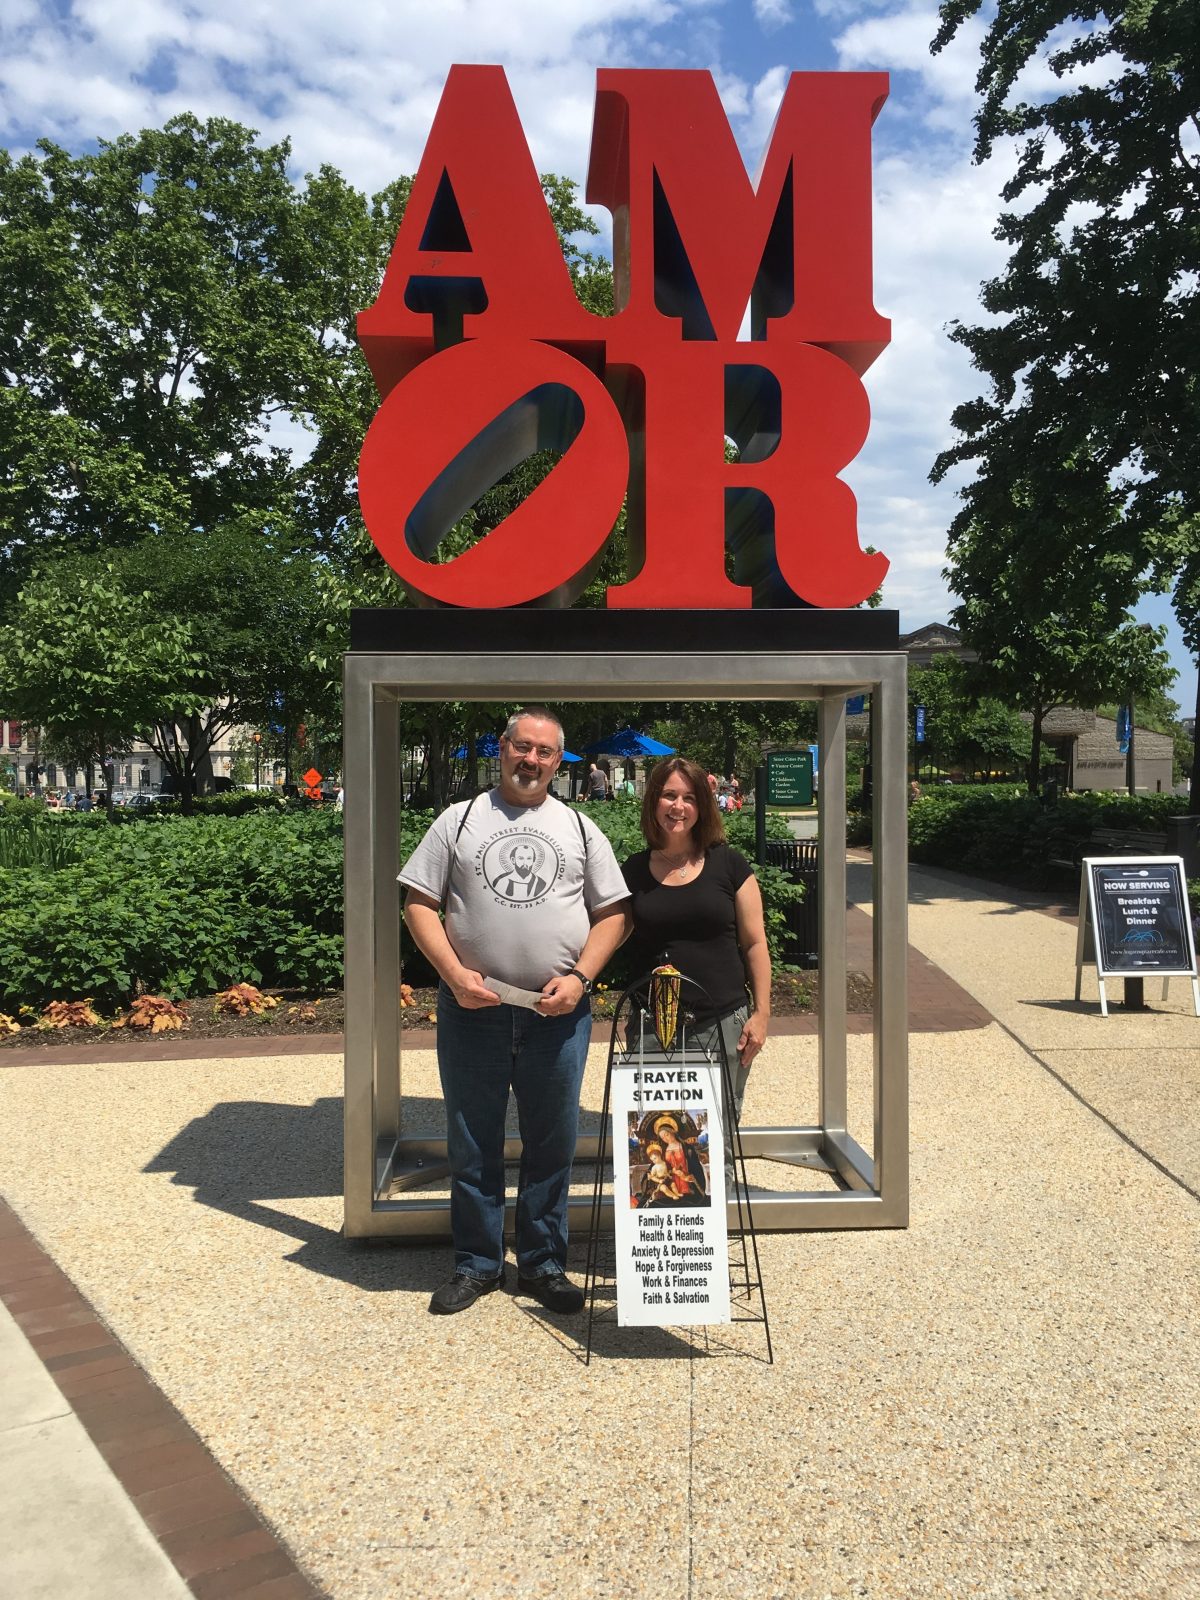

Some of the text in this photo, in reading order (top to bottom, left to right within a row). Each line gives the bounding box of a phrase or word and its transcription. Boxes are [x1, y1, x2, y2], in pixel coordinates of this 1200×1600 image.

[475, 841, 489, 859] PAUL
[490, 827, 518, 840] STREET
[523, 826, 566, 880] EVANGELIZATION
[1104, 882, 1170, 890] NOW SERVING
[634, 1071, 698, 1083] PRAYER
[633, 1089, 703, 1102] STATION
[638, 1214, 704, 1229] Family & Friends
[640, 1229, 704, 1243] Health & Healing
[632, 1244, 714, 1259] Anxiety & Depression
[636, 1260, 712, 1275] Hope & Forgiveness
[642, 1275, 707, 1287] Work & Finances
[643, 1292, 709, 1304] Faith & Salvation
